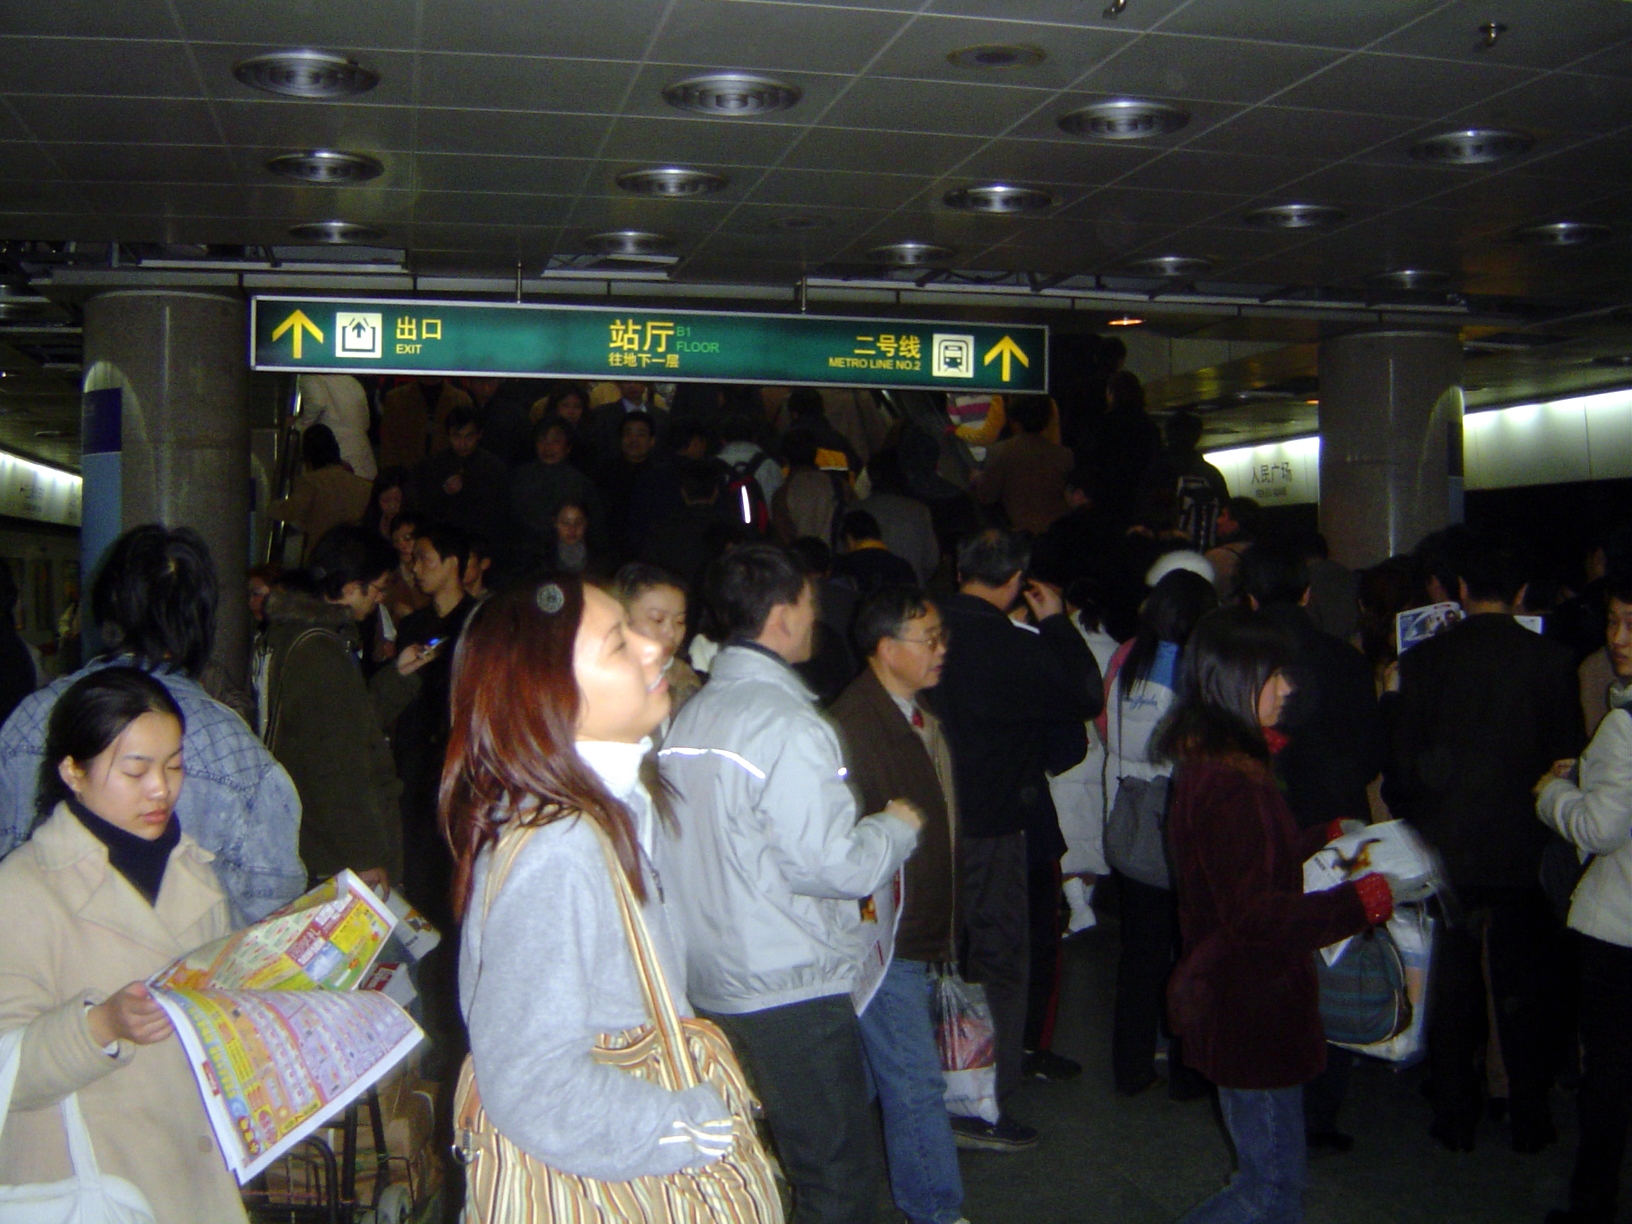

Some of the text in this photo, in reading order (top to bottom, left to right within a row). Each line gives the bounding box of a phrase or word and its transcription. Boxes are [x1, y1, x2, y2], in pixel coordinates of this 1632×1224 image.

[397, 316, 441, 340] 出口
[609, 319, 674, 352] 站厅
[676, 325, 691, 337] B1
[396, 344, 422, 354] EXIT
[676, 340, 720, 353] FLOOR
[853, 334, 921, 359] 二号线
[608, 352, 679, 368] 往地下一层
[828, 356, 869, 370] METRO
[869, 358, 894, 371] LINE
[1251, 462, 1292, 484] 人民广场
